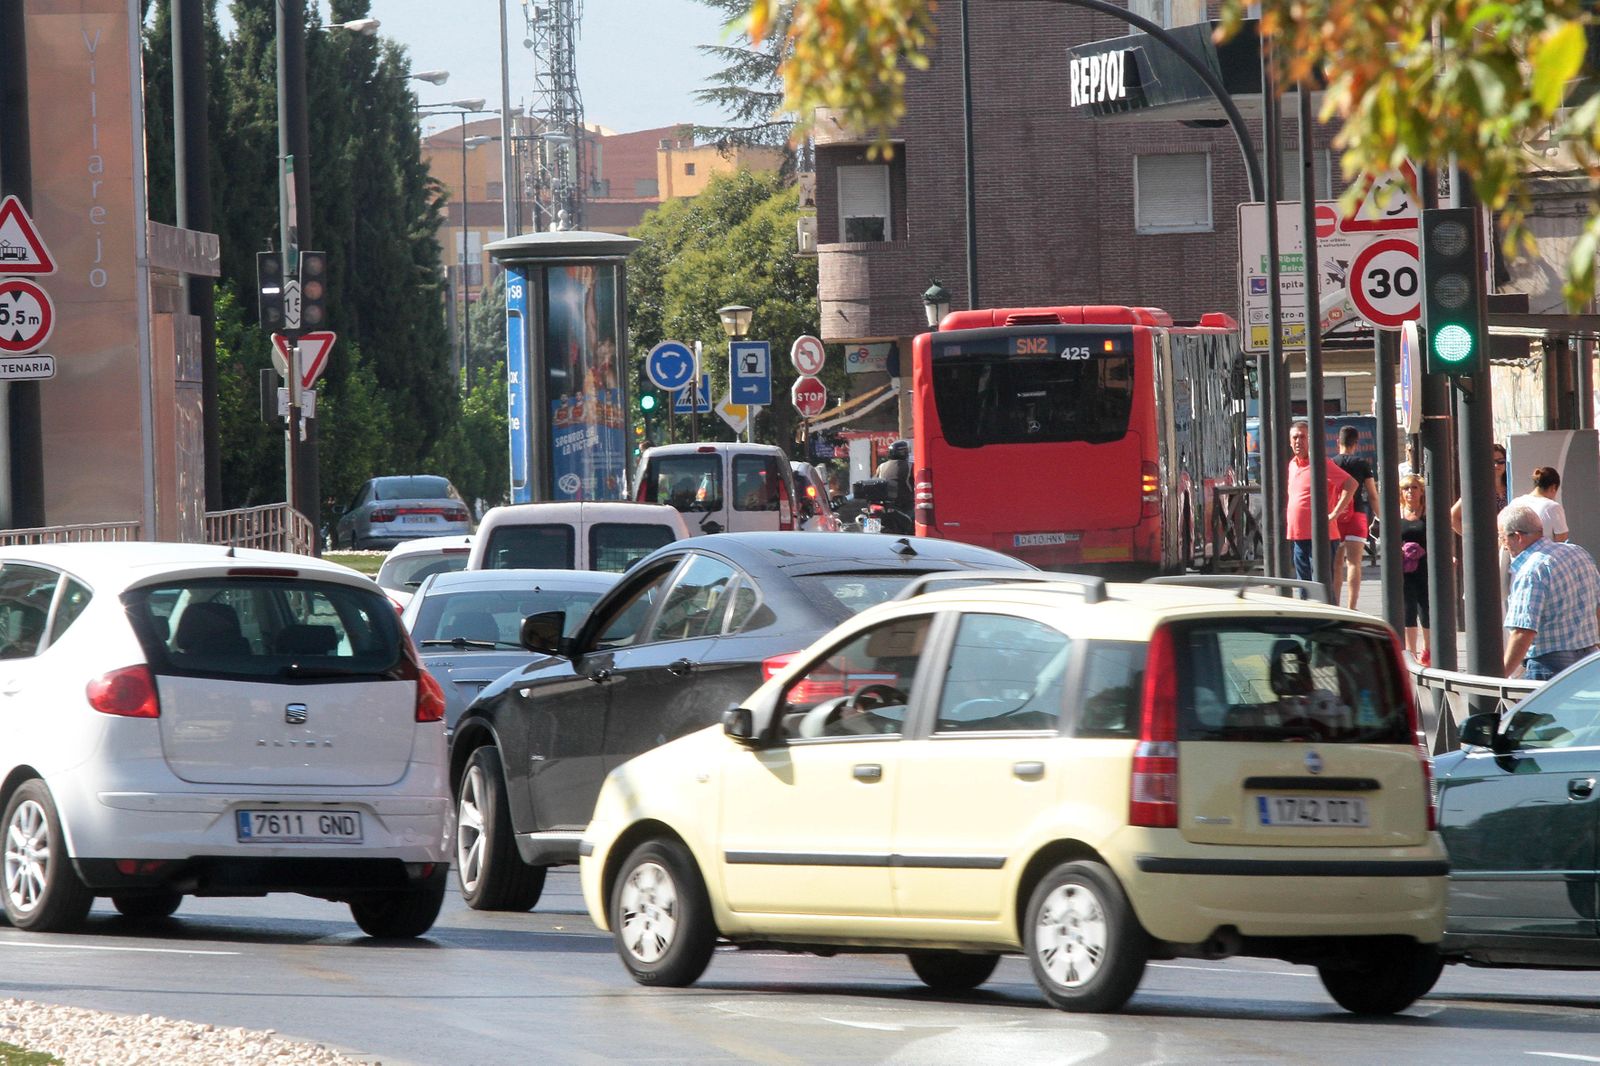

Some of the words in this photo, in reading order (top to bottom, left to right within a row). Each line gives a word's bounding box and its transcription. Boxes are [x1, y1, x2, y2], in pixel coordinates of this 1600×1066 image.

[1070, 50, 1126, 107] REPSOL
[81, 29, 108, 288] Villarejo
[1368, 266, 1418, 299] 30
[285, 298, 301, 313] 15
[28, 316, 39, 326] m
[1016, 338, 1049, 354] SN2
[1060, 347, 1090, 360] 425
[1, 363, 50, 373] TENARIA
[797, 392, 823, 402] STOP
[255, 814, 304, 834] 7611
[319, 815, 355, 835] GND
